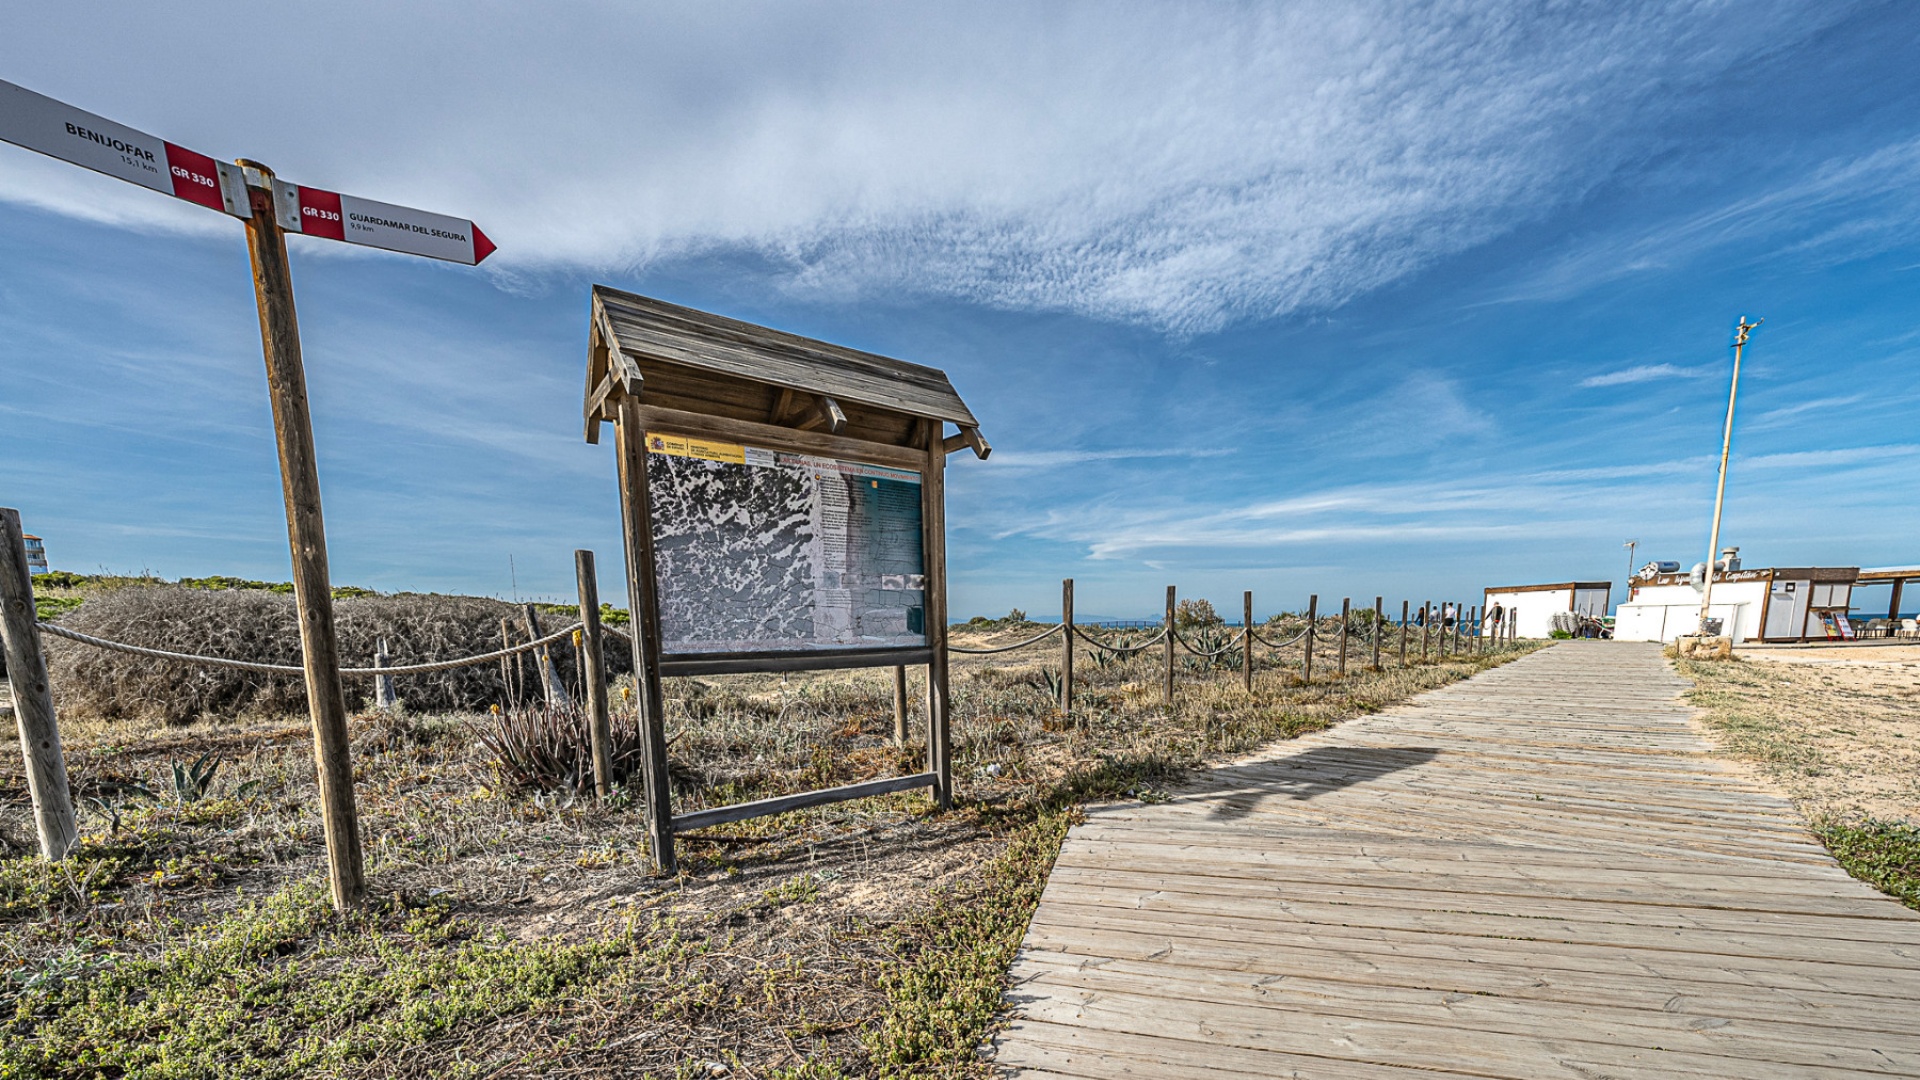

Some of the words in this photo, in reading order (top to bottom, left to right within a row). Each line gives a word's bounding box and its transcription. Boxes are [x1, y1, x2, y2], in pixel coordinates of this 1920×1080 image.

[65, 122, 155, 162] BENIJOFAR
[121, 155, 140, 168] 15,1
[142, 161, 157, 173] km
[171, 165, 191, 180] GR
[192, 171, 215, 188] 330
[302, 206, 319, 218] GR
[319, 209, 340, 222] 330
[350, 213, 410, 231] GUARDAMAR
[412, 223, 430, 235] DEL
[431, 228, 466, 242] SEGURA
[350, 222, 362, 231] 9,9
[362, 223, 375, 233] km
[822, 463, 856, 473] ECOSISTEMA
